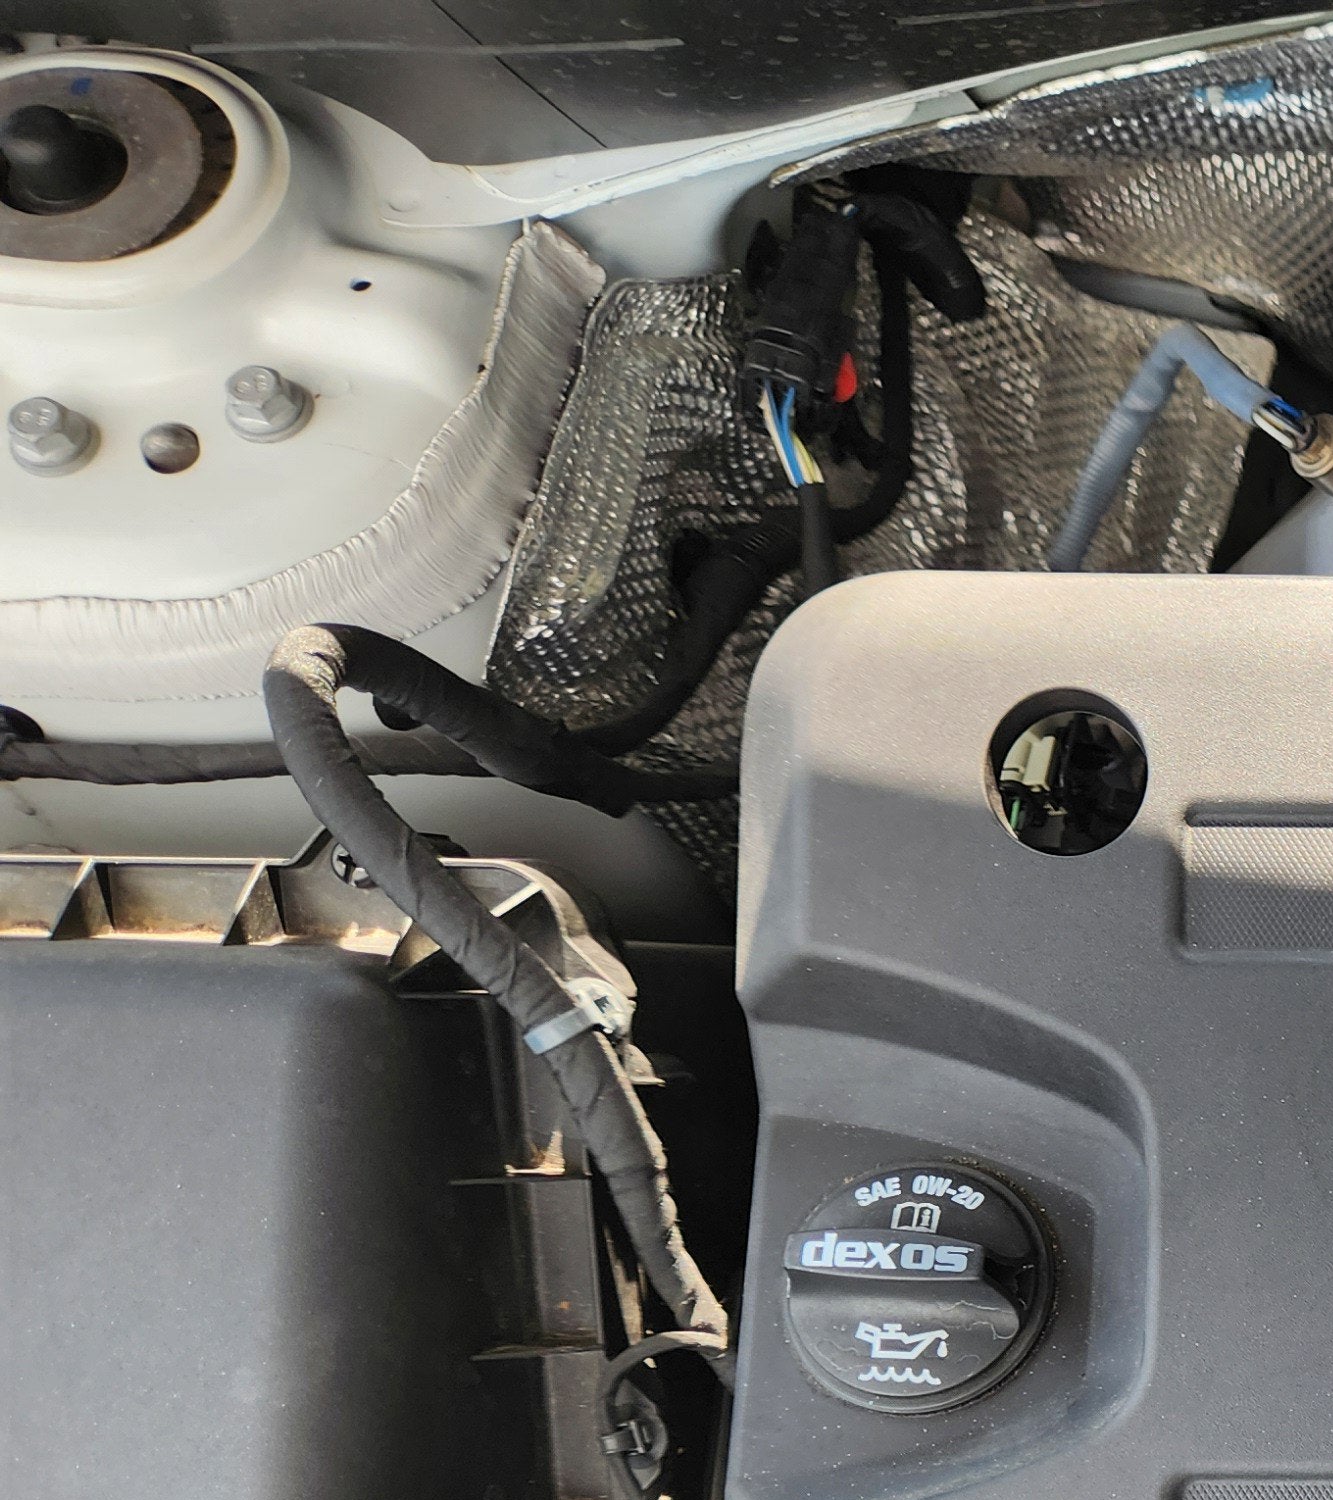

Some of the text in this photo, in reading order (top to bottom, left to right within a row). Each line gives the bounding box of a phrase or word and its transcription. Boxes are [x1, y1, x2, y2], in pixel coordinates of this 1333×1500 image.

[854, 1175, 985, 1210] SAE 0W-20
[800, 1232, 975, 1273] dexos
